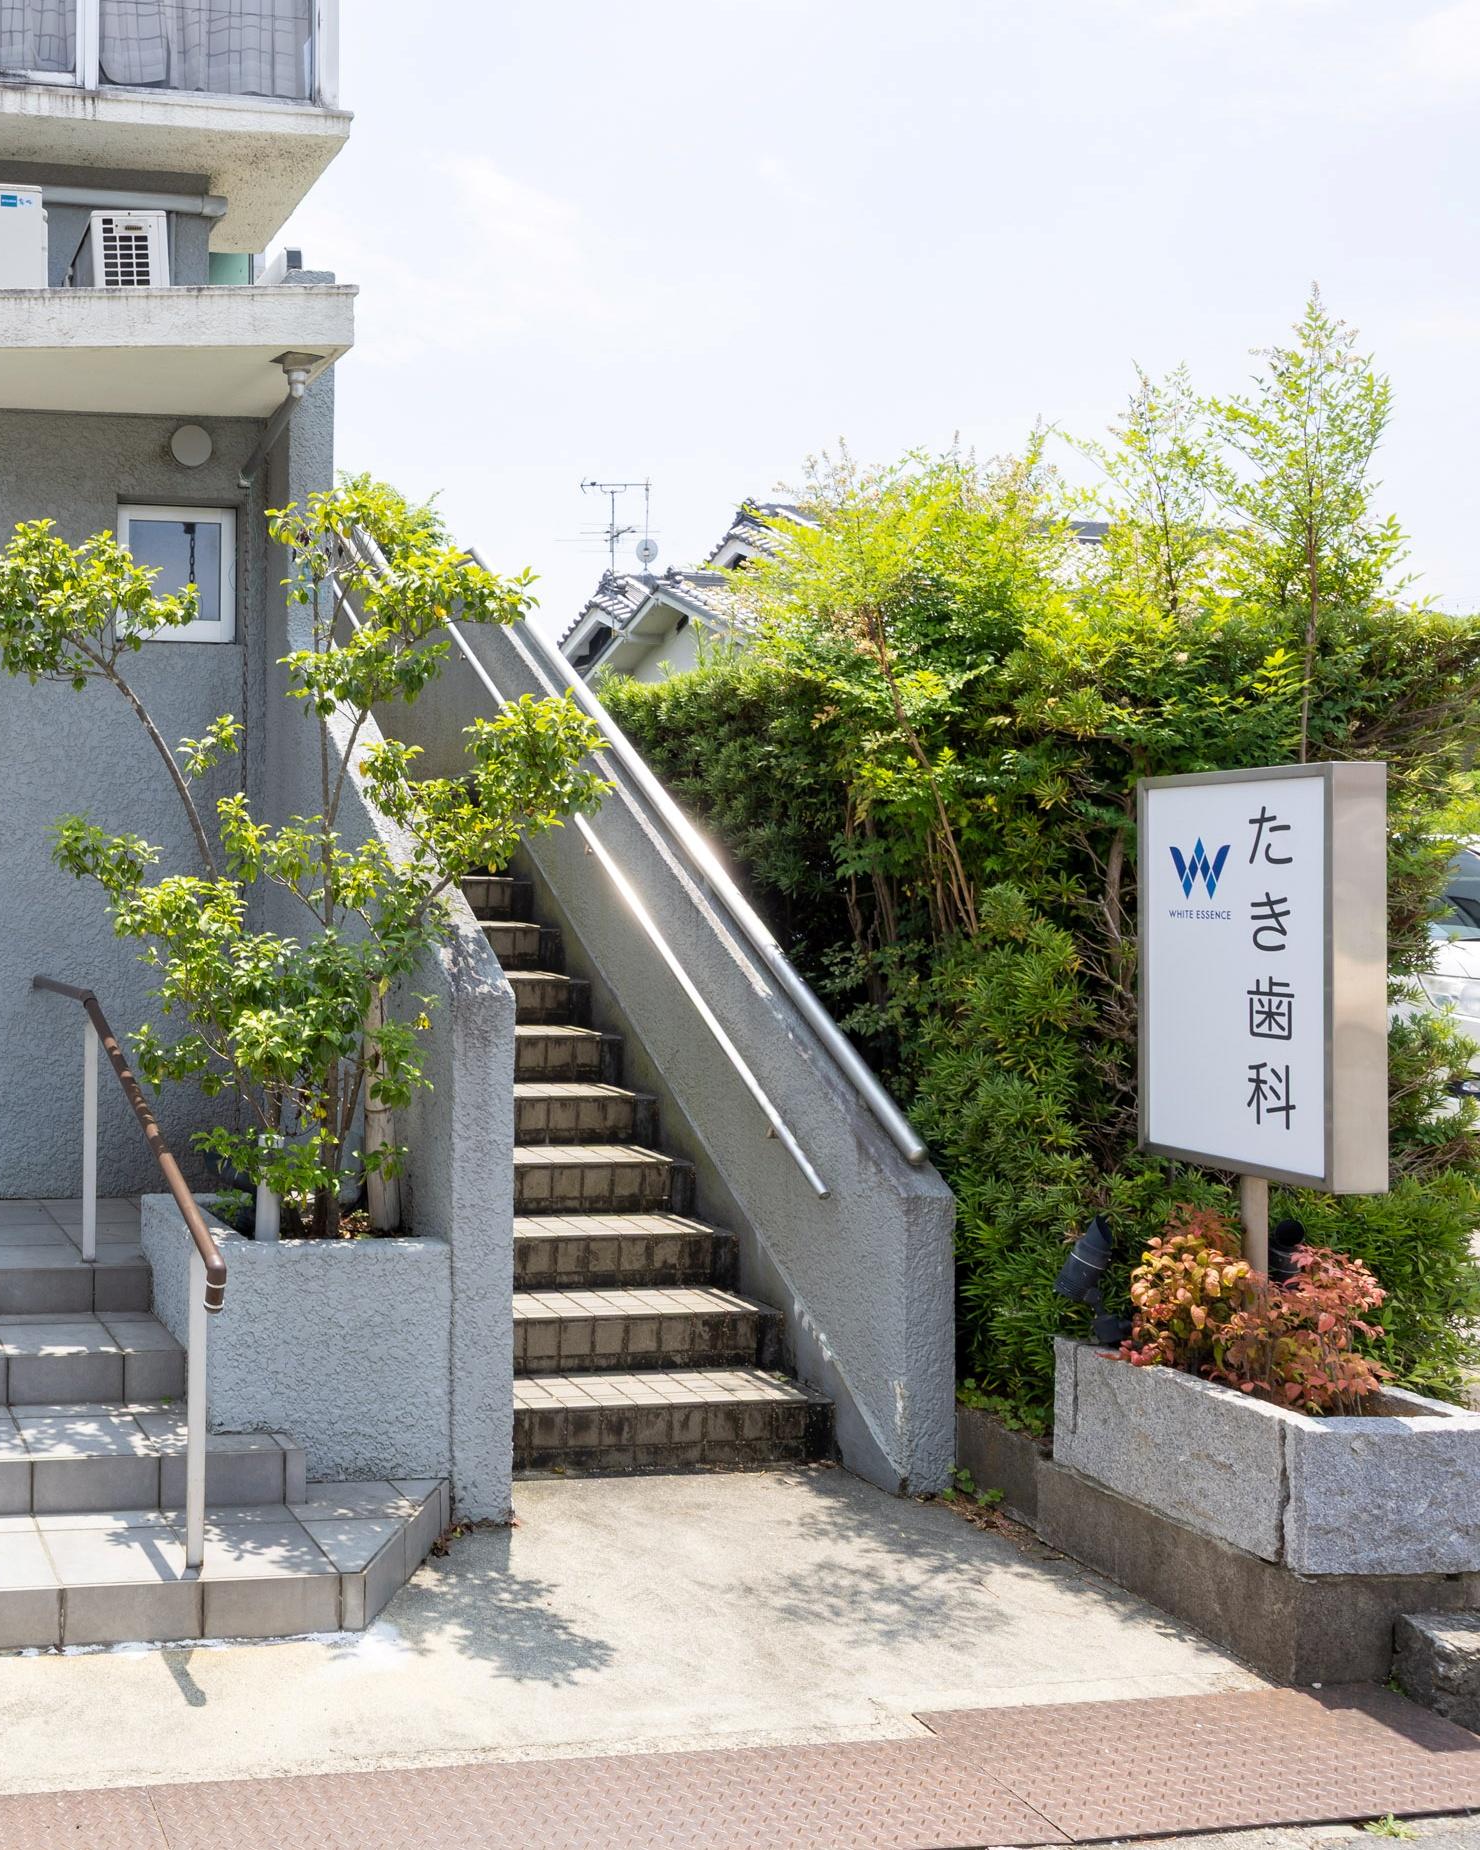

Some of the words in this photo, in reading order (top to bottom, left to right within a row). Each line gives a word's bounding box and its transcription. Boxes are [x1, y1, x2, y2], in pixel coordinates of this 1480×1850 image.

[1168, 909, 1194, 920] WHITE
[1195, 910, 1232, 921] ESSENCE
[1246, 805, 1296, 1131] たき歯科
